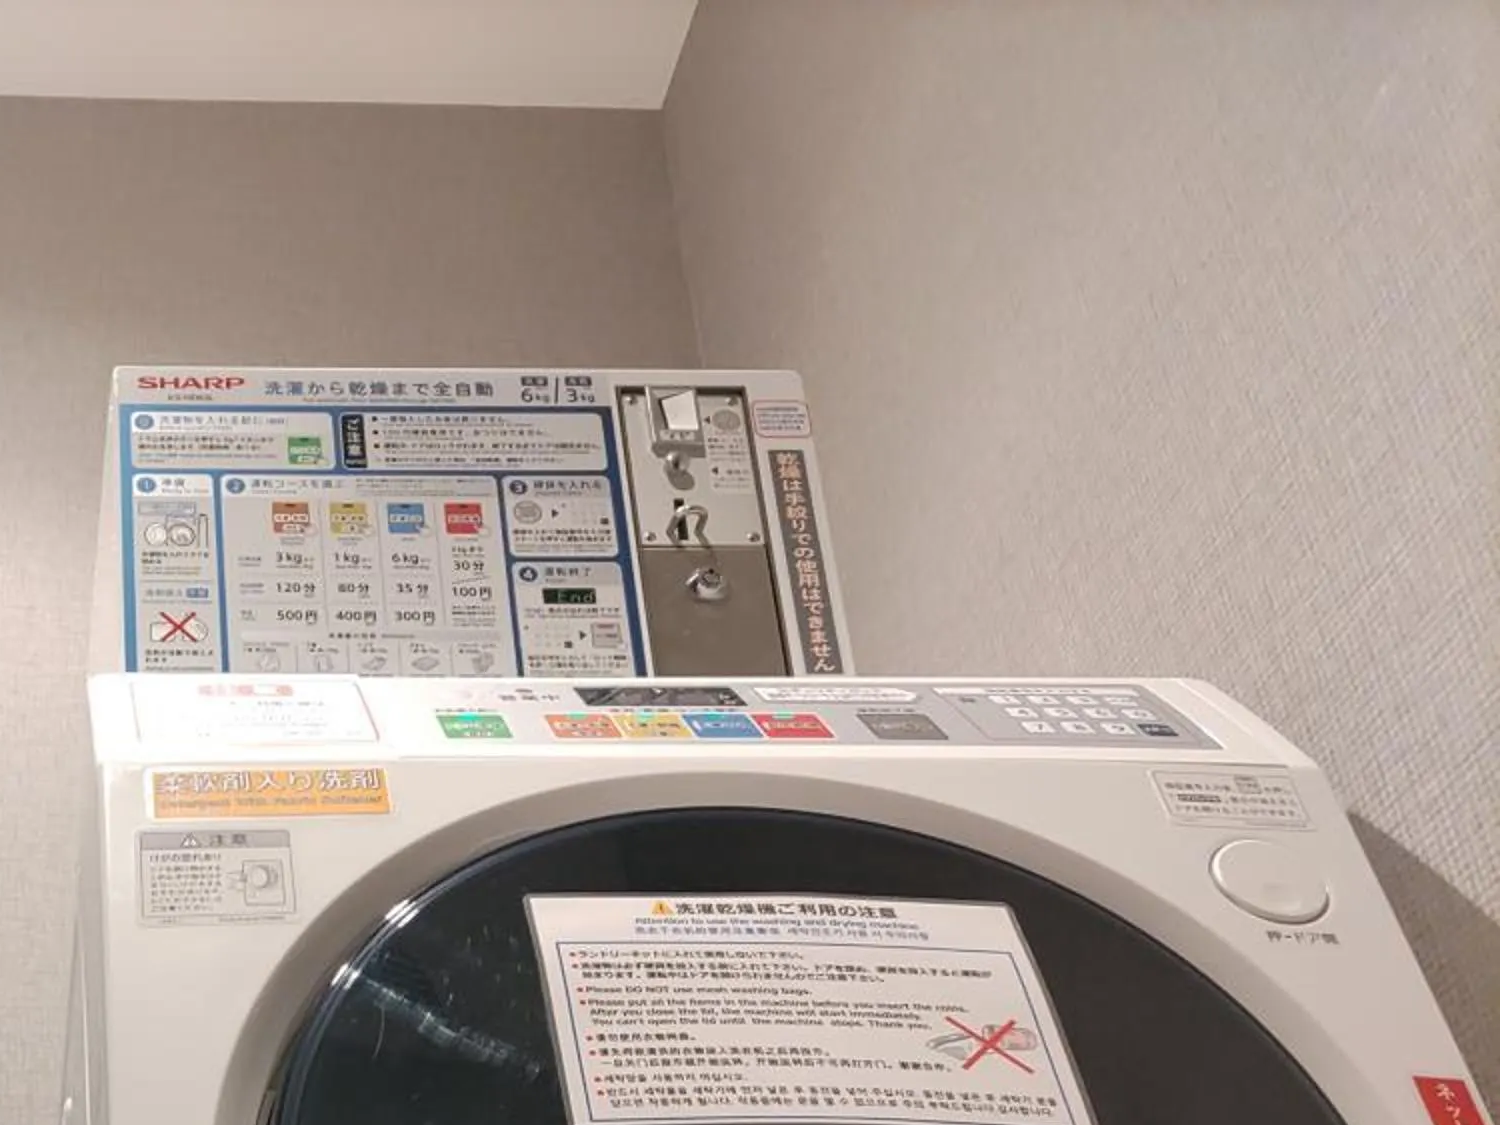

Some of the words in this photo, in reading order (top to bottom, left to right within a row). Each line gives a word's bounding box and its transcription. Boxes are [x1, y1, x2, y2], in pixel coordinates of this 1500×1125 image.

[136, 376, 245, 390] SHARP
[264, 380, 494, 397] 洗濯から乾燥まで全自動
[775, 453, 836, 673] 乾燥は手絞りでの使用はできません
[275, 609, 319, 624] 500円
[334, 609, 377, 624] 400円
[162, 767, 381, 793] 柔軟剤入り洗剤
[675, 902, 898, 920] 洗濯乾燥機ご利用の注意
